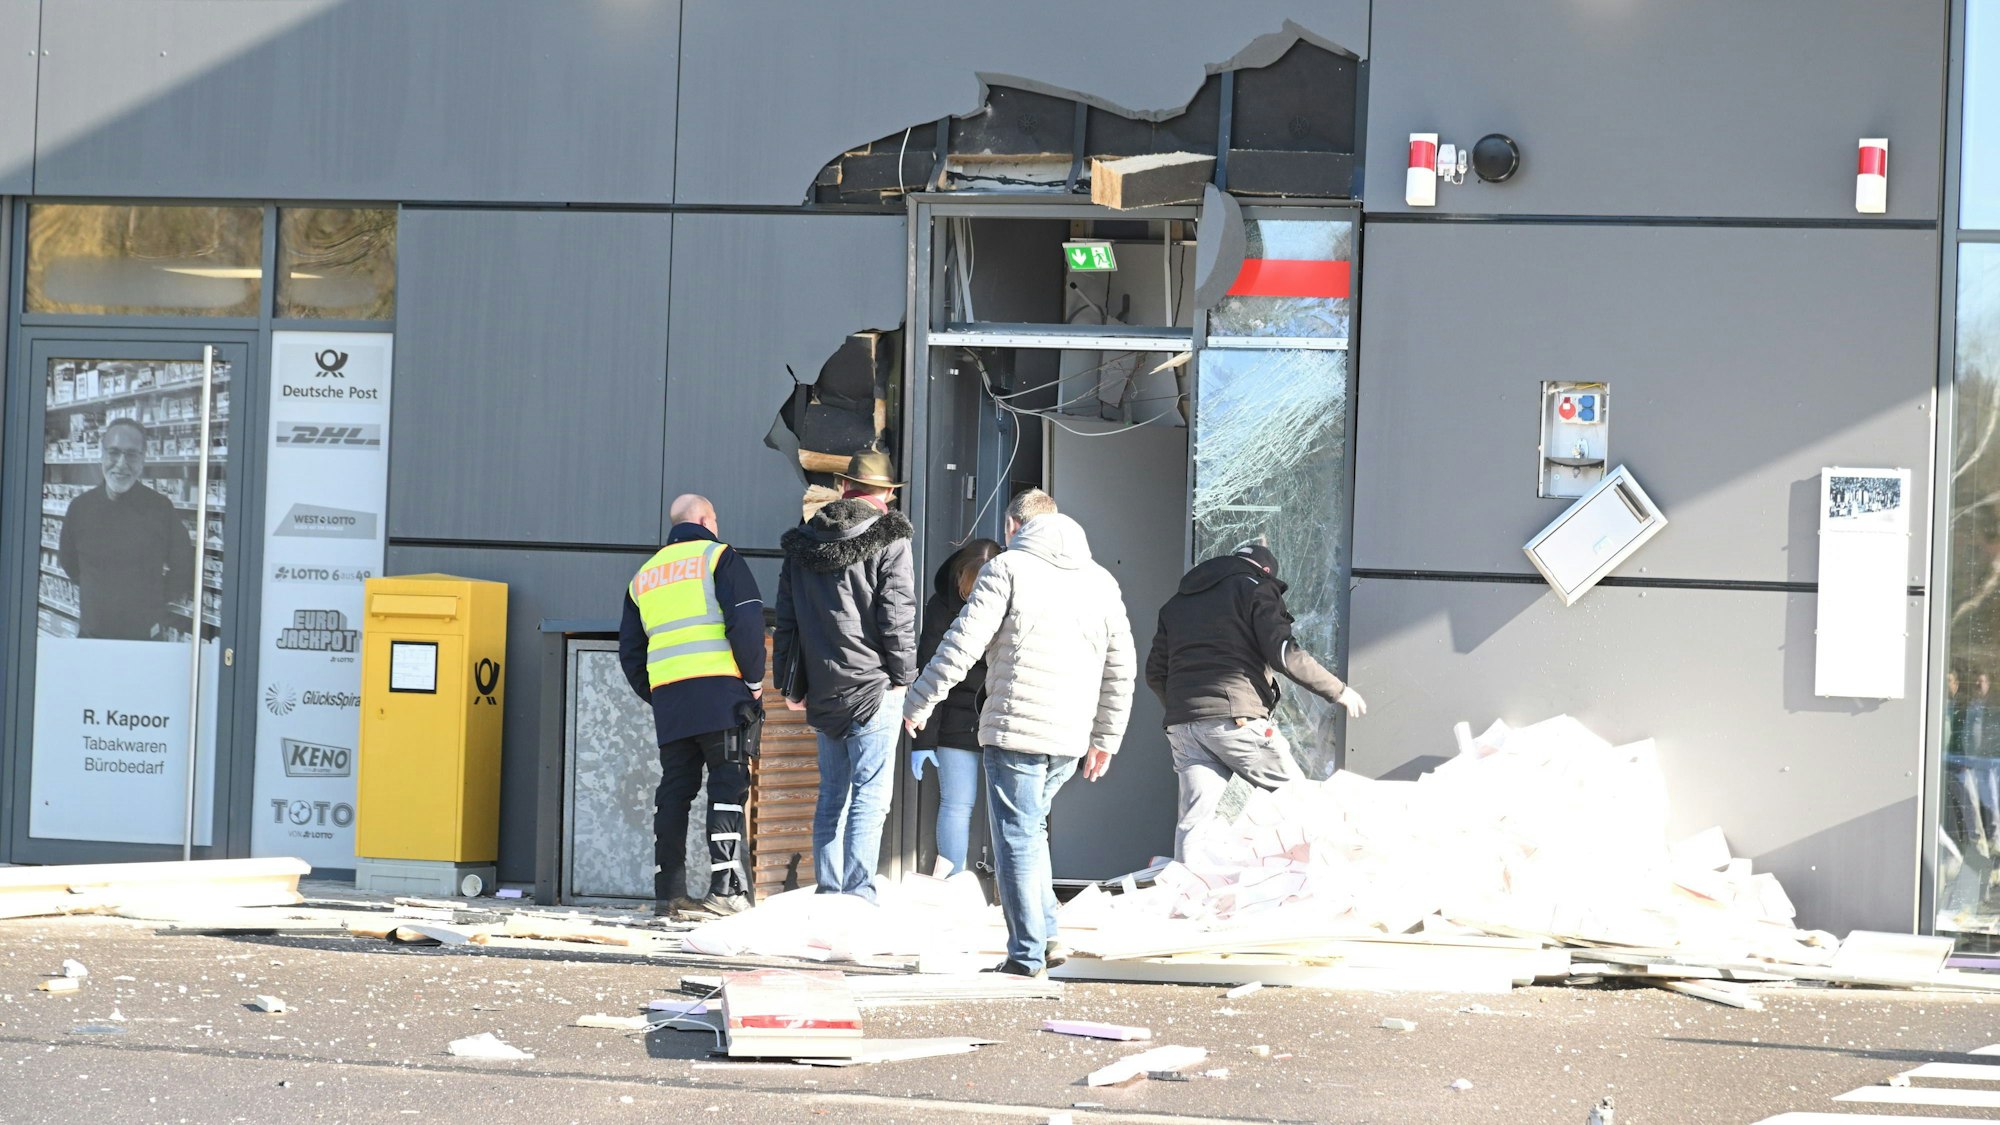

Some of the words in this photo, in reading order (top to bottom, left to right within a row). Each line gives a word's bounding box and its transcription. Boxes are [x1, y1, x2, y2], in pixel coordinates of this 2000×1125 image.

[283, 385, 344, 399] Deutsche
[349, 386, 378, 400] Post
[290, 426, 367, 445] DHL
[291, 568, 329, 581] LOTTO
[332, 569, 340, 581] 6
[638, 556, 704, 594] POLIZEI
[293, 609, 343, 631] EURO
[276, 628, 357, 653] JACKPOT
[302, 690, 361, 710] GlücksSpira
[83, 709, 100, 726] R.
[106, 710, 170, 730] Kapoor
[83, 736, 167, 753] Tabakwaren
[84, 757, 165, 775] Bürobedarf
[290, 745, 348, 769] KENO
[271, 798, 355, 828] TOTO
[311, 831, 334, 839] LOTTO
